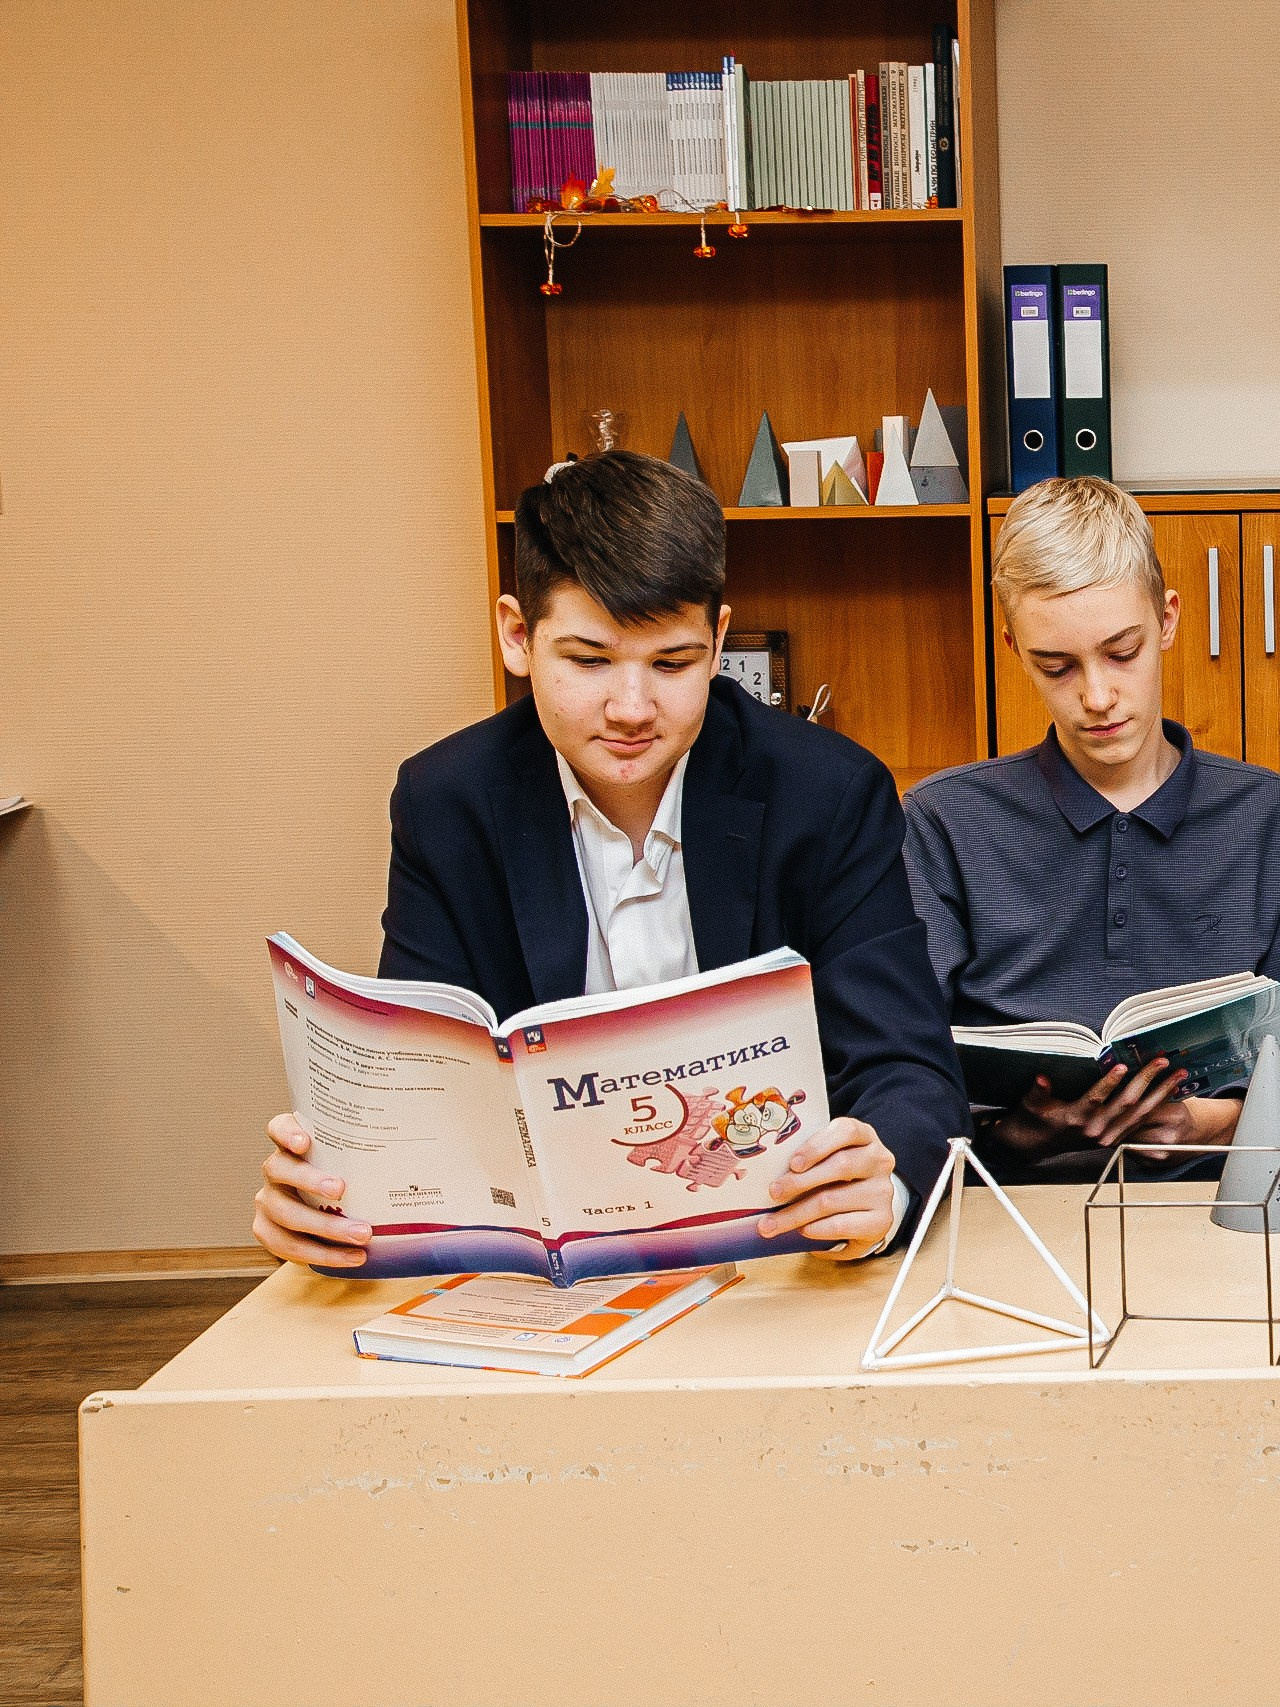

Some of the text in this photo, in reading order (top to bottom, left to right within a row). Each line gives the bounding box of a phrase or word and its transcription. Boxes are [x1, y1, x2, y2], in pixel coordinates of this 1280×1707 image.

[929, 120, 937, 163] ГЕОМЕТРИИ
[739, 660, 745, 672] 1
[753, 671, 762, 686] 2
[547, 1036, 790, 1111] Математика
[630, 1095, 658, 1122] 5
[623, 1120, 674, 1136] КЛАСС
[514, 1108, 537, 1168] МАТЕМАТИКА
[643, 1200, 655, 1210] 1
[542, 1217, 551, 1227] 5
